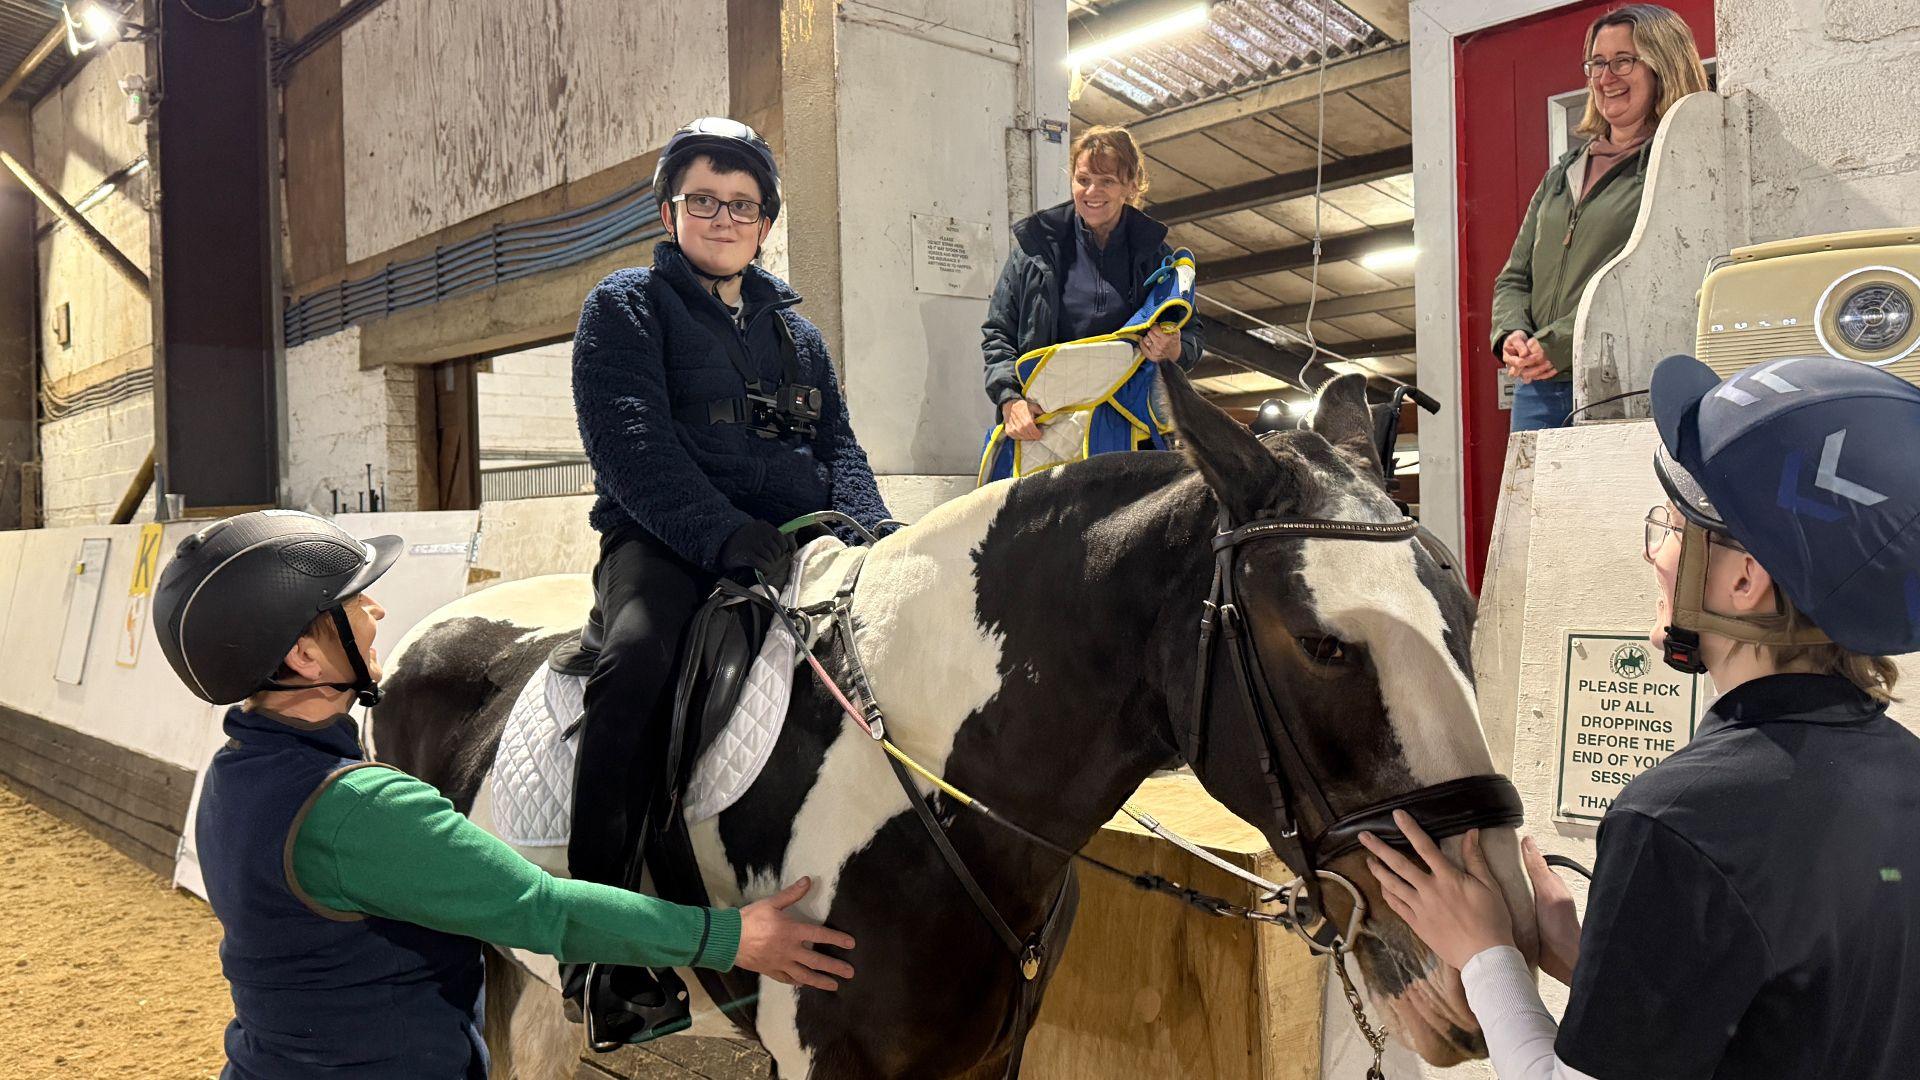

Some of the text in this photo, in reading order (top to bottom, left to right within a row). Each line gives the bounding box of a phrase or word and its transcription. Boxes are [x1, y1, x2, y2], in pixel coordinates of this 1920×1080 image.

[134, 533, 158, 588] K
[1579, 679, 1680, 696] PLEASE PICK
[1601, 698, 1654, 713] UP ALL
[1581, 715, 1672, 733] DROPPINGS
[1577, 733, 1675, 752] BEFORE THE
[1572, 750, 1603, 764] END
[1608, 753, 1629, 766] OF
[1579, 795, 1614, 809] THA
